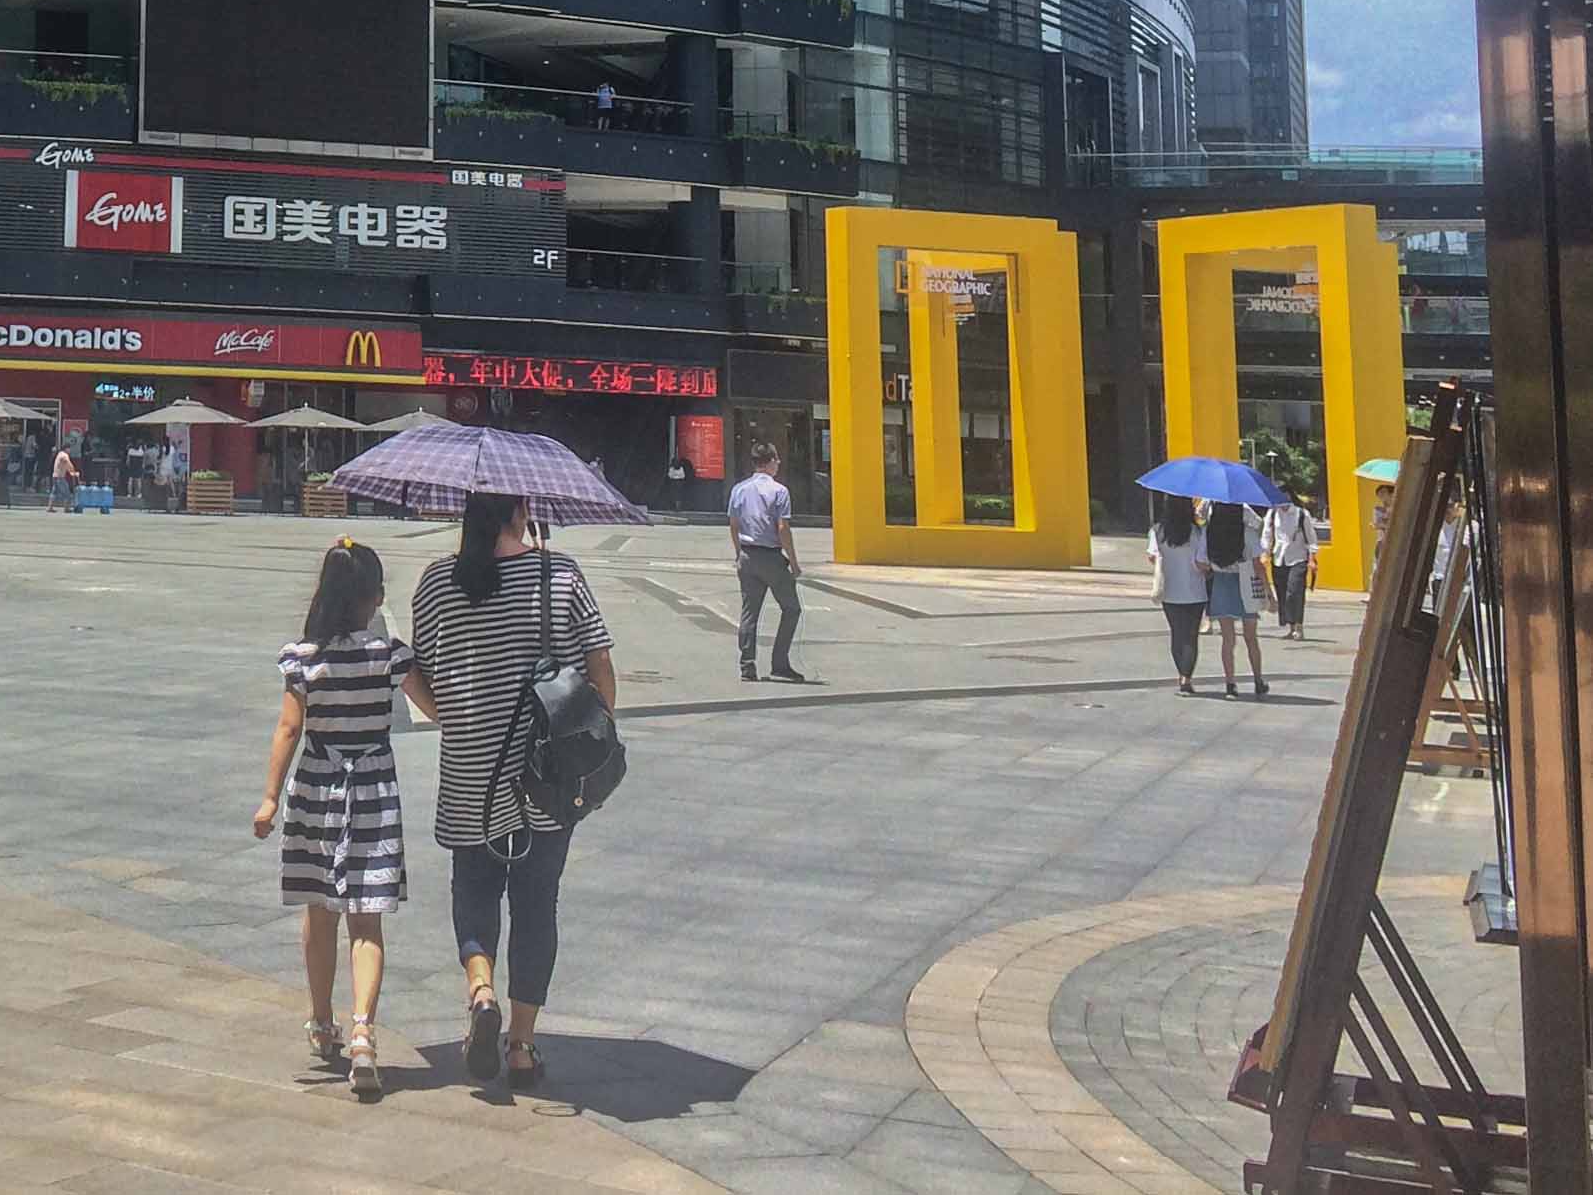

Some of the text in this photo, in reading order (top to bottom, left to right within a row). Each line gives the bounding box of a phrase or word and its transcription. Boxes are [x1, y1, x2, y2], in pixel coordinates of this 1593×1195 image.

[450, 169, 525, 191] 国美电器
[223, 194, 449, 251] 国美电器
[532, 248, 559, 270] 2F
[921, 266, 977, 281] NATIONAL
[921, 279, 993, 296] GEOGRAPHIC
